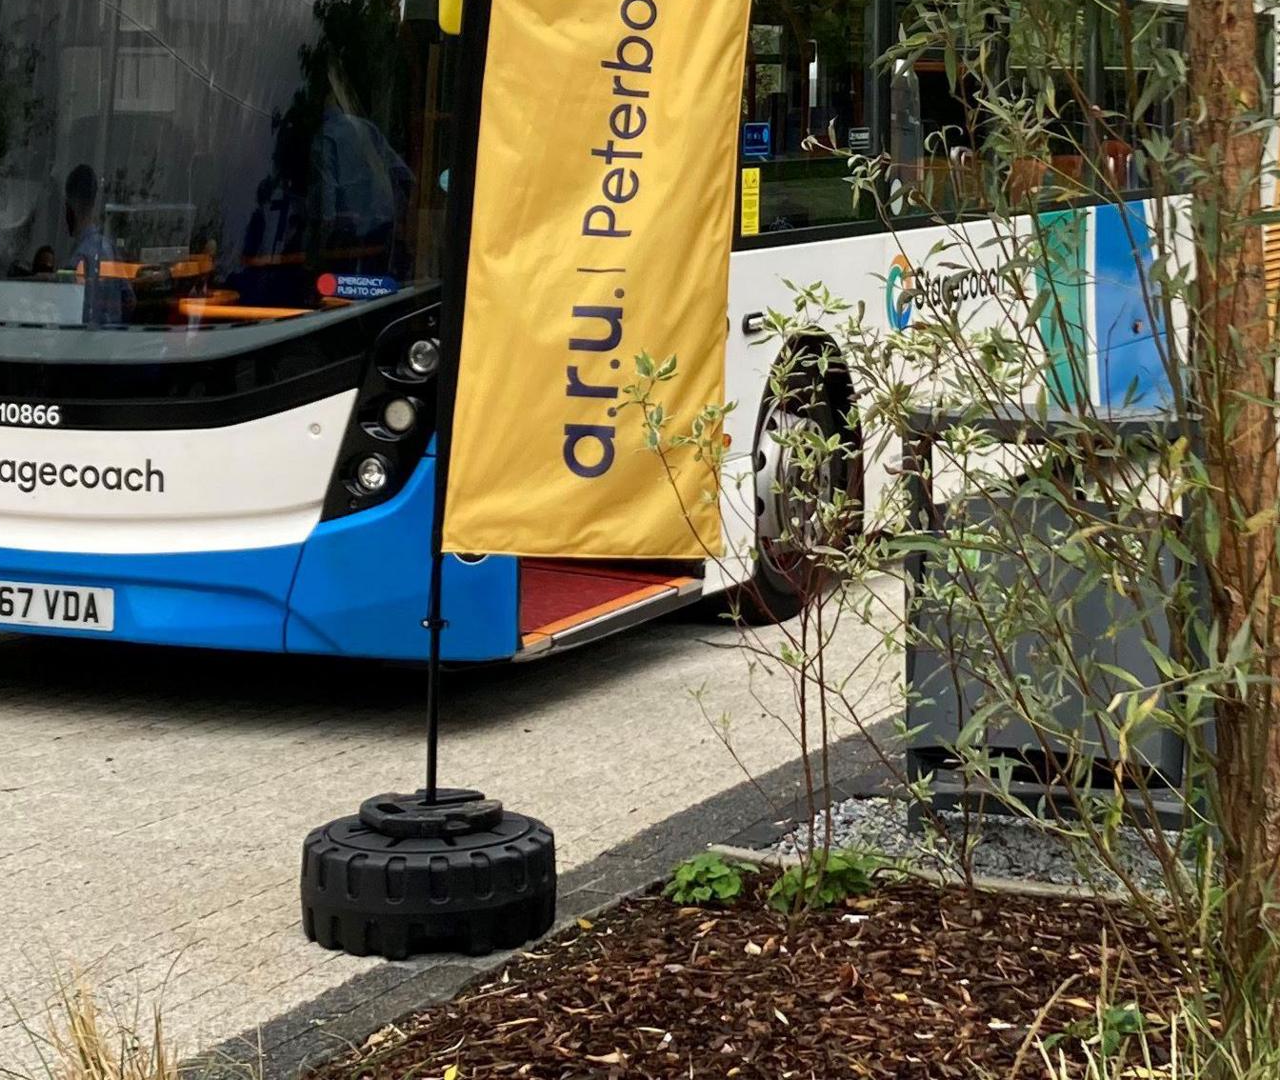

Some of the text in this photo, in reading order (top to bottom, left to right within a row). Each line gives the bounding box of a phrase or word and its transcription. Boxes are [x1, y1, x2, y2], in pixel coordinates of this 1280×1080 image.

[337, 276, 383, 287] EMERGENCY
[337, 286, 357, 295] PUSH
[358, 287, 369, 296] TO
[562, 287, 625, 479] a.r.u.
[44, 588, 99, 624] VDA
